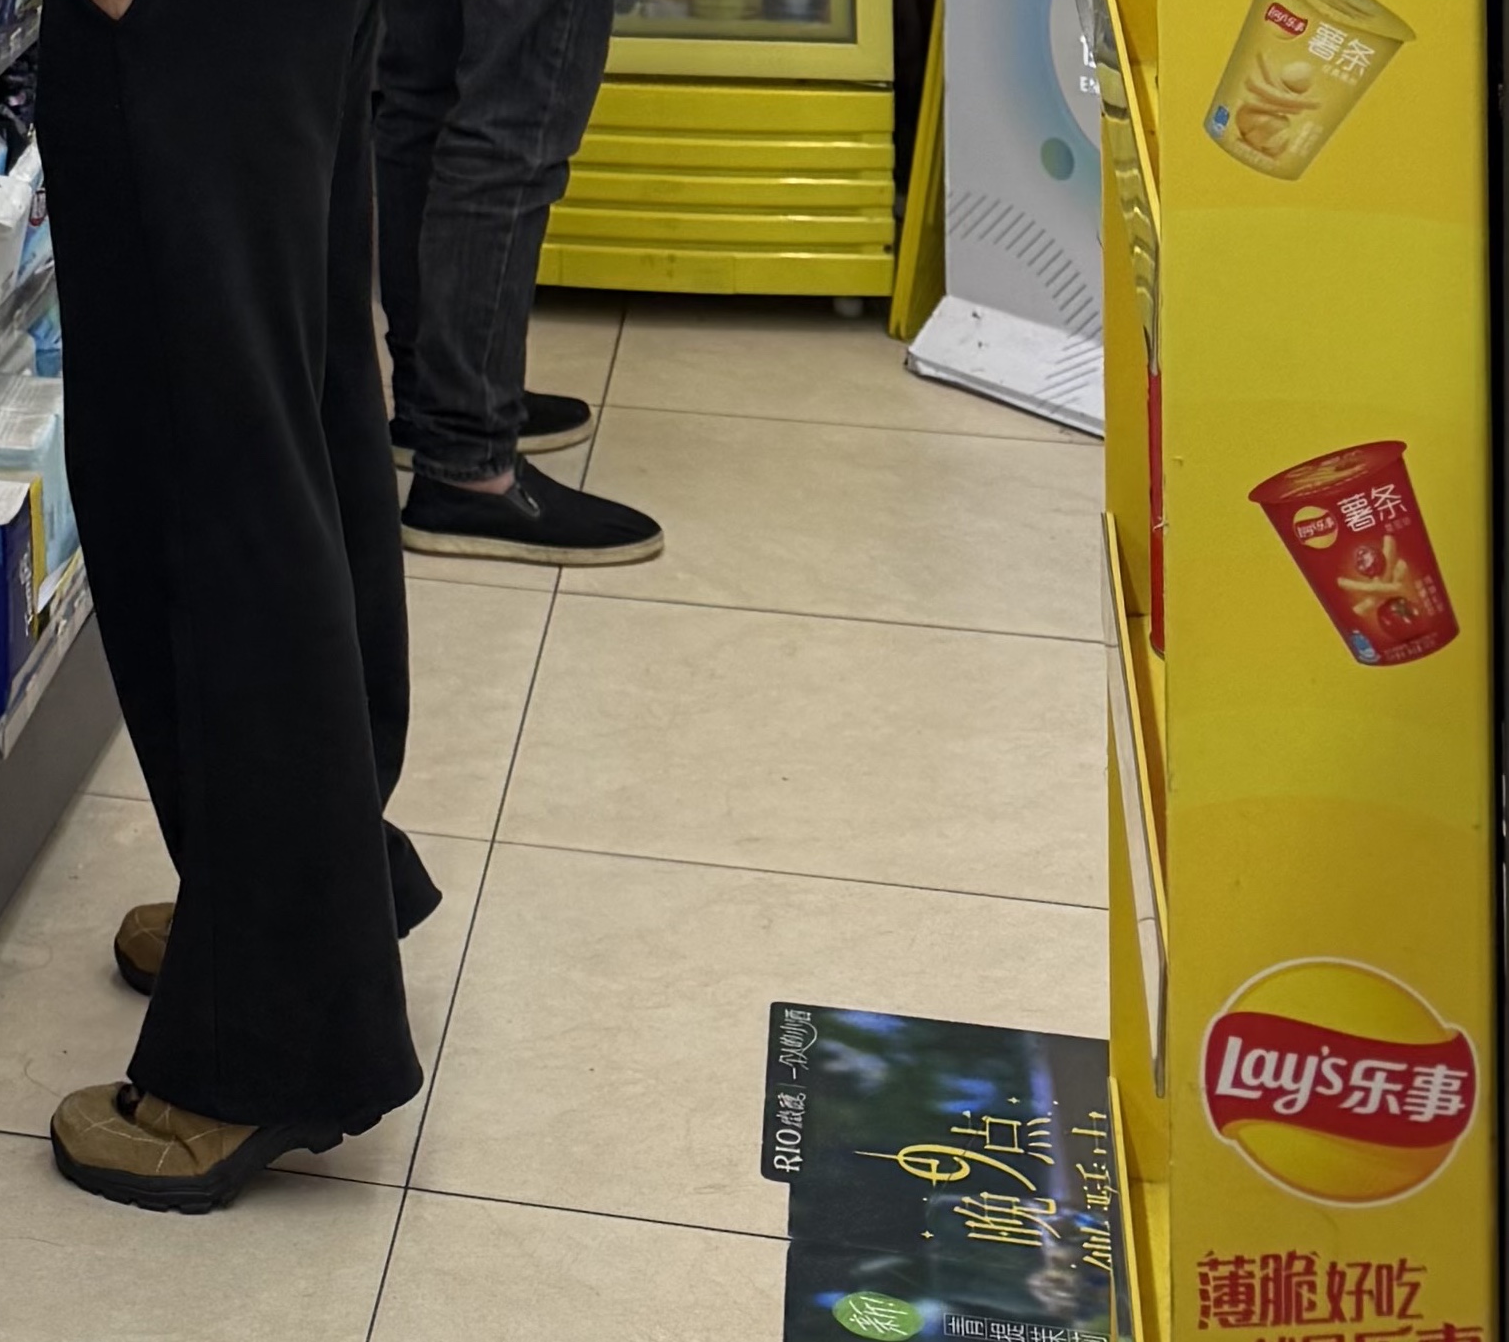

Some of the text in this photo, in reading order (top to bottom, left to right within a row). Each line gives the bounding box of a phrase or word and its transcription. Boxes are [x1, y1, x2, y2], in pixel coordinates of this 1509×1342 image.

[1308, 21, 1376, 77] 薯条
[1336, 483, 1408, 532] 薯条
[1196, 1248, 1428, 1332] 薄脆好吃
